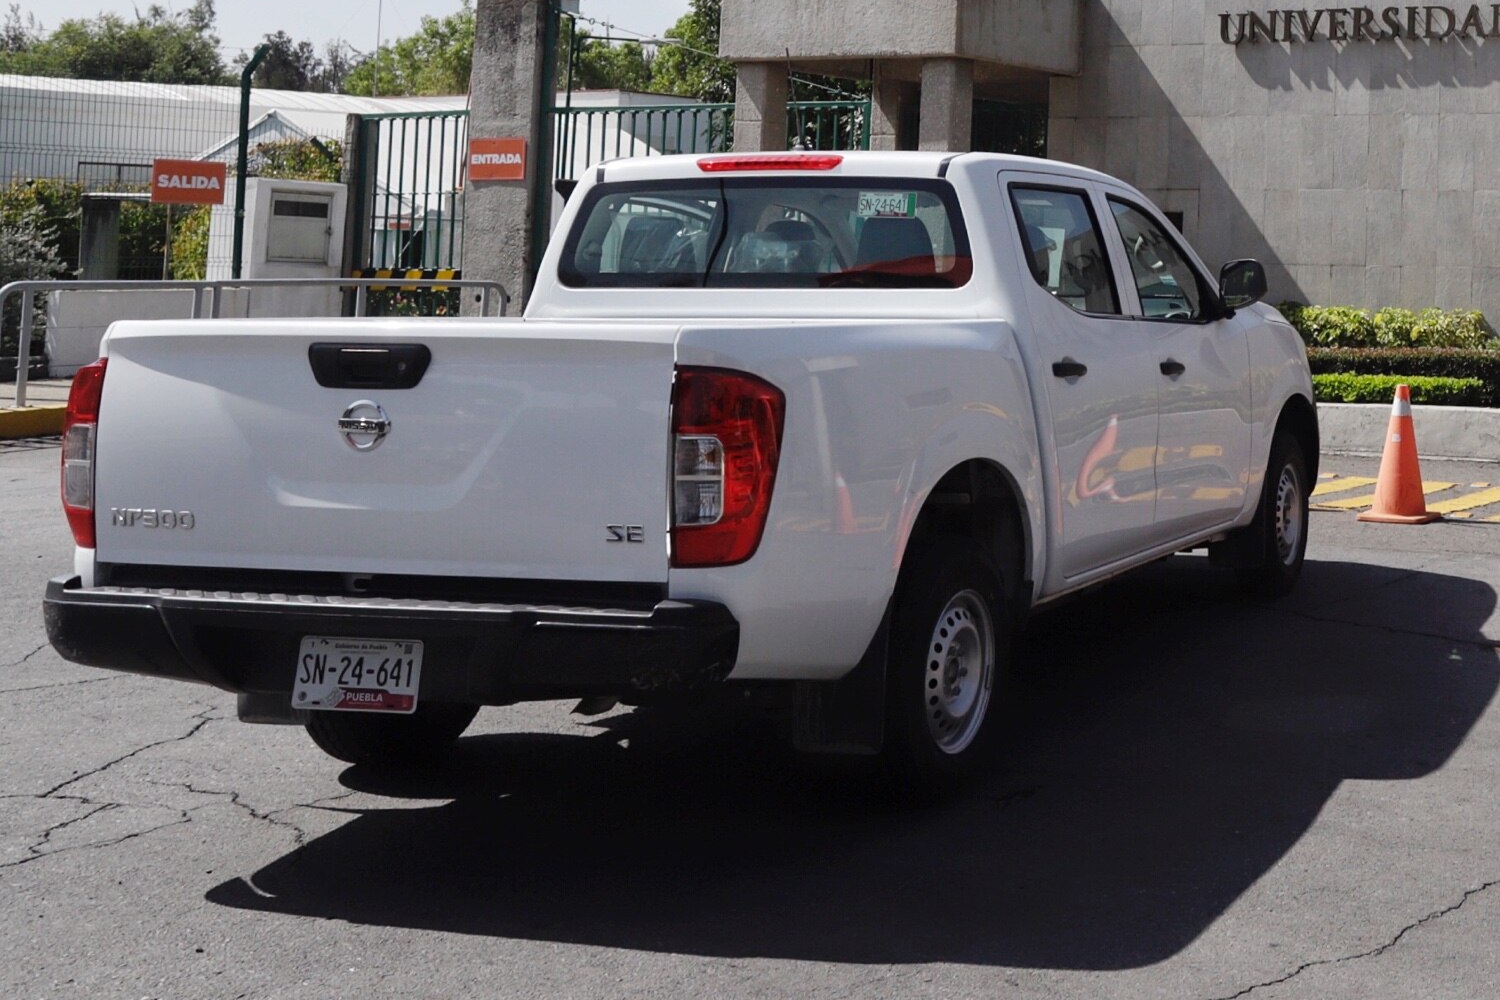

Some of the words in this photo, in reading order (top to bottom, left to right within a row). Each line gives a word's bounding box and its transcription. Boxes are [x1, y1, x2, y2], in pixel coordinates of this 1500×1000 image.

[471, 153, 522, 165] ENTRADA
[157, 174, 221, 190] SALIDA
[860, 198, 906, 213] SN-24-641
[110, 507, 195, 530] NP300
[606, 523, 643, 543] SE
[300, 653, 414, 688] SN-24-641
[346, 691, 383, 702] PUEBLA
